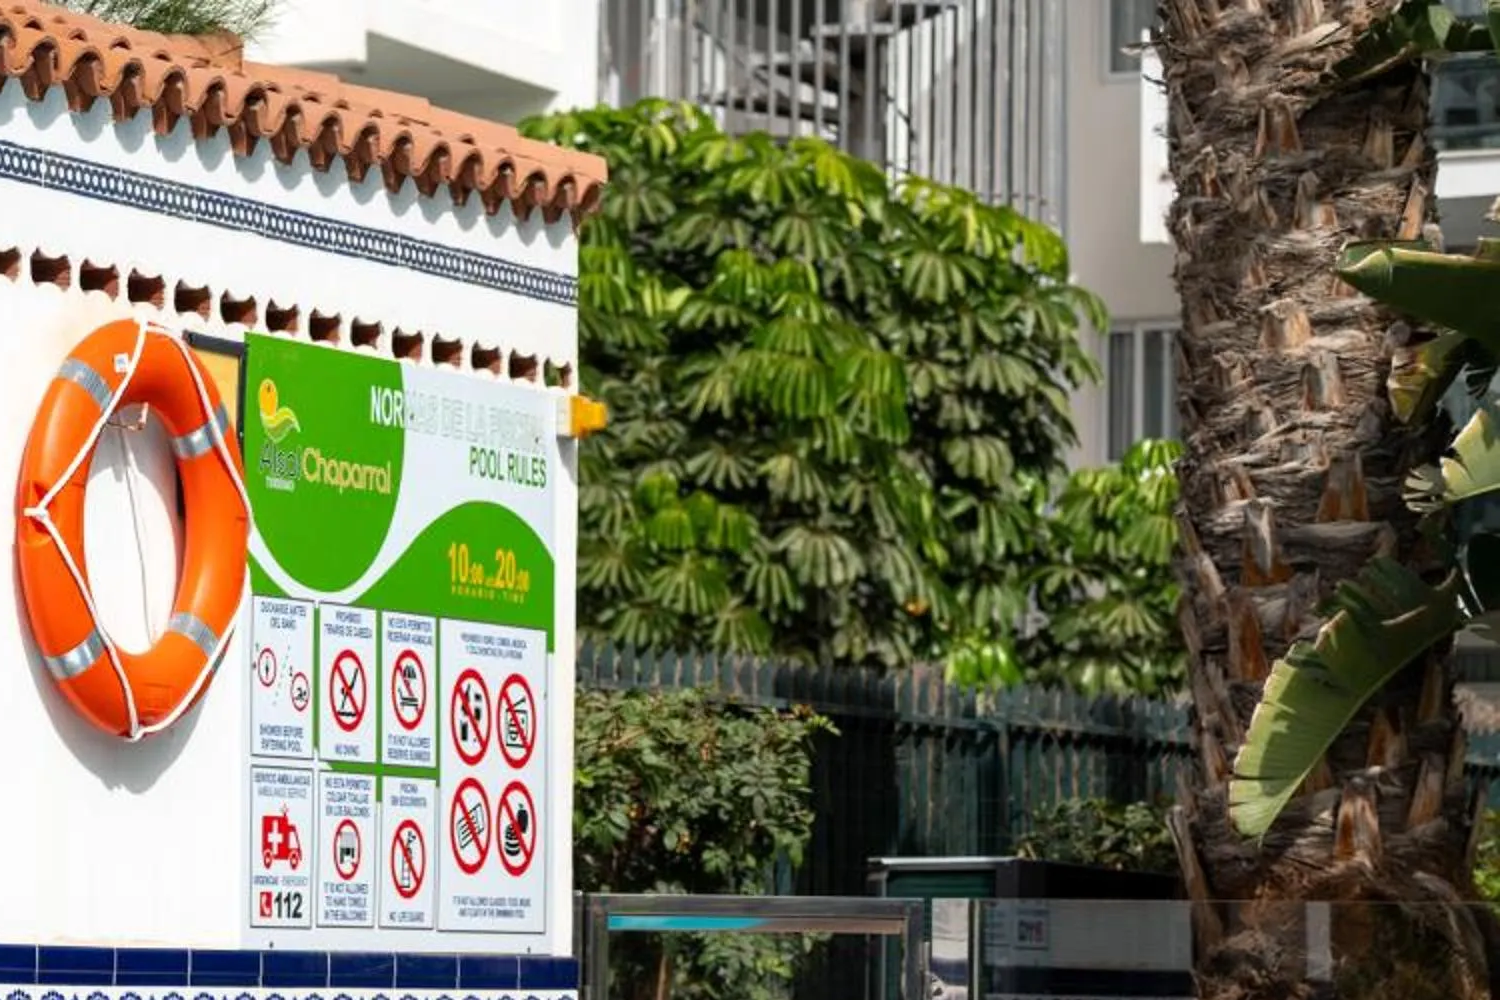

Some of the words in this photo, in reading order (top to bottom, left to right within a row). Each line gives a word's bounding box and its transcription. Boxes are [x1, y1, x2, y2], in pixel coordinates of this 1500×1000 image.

[302, 446, 392, 495] Chaparral
[469, 445, 505, 481] POOL
[507, 453, 547, 489] RULES
[274, 892, 303, 919] 112
